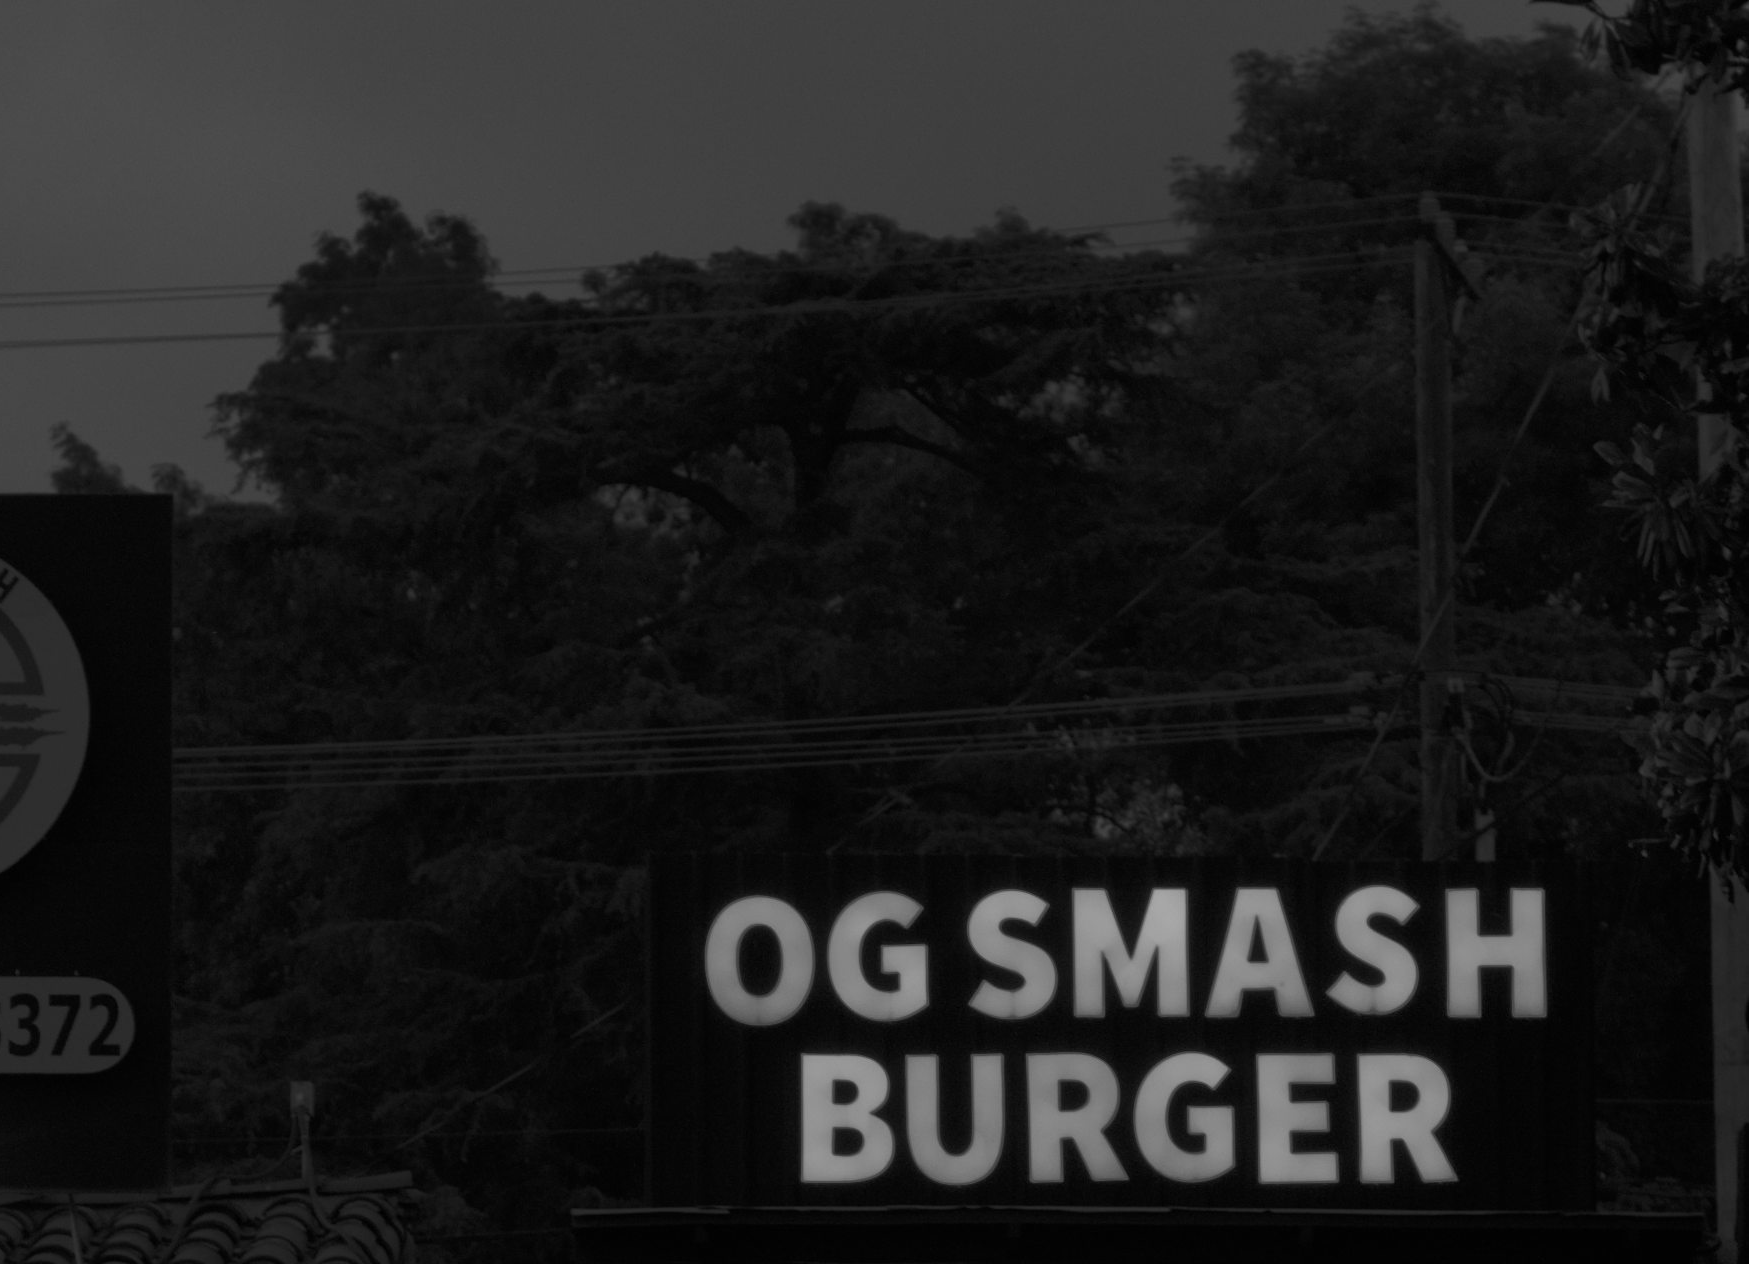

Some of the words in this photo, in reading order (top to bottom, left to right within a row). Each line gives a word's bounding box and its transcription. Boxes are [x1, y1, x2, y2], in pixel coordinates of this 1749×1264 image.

[703, 890, 931, 1027] OG
[966, 884, 1549, 1021] SMASH
[799, 1050, 1460, 1186] BURGER
